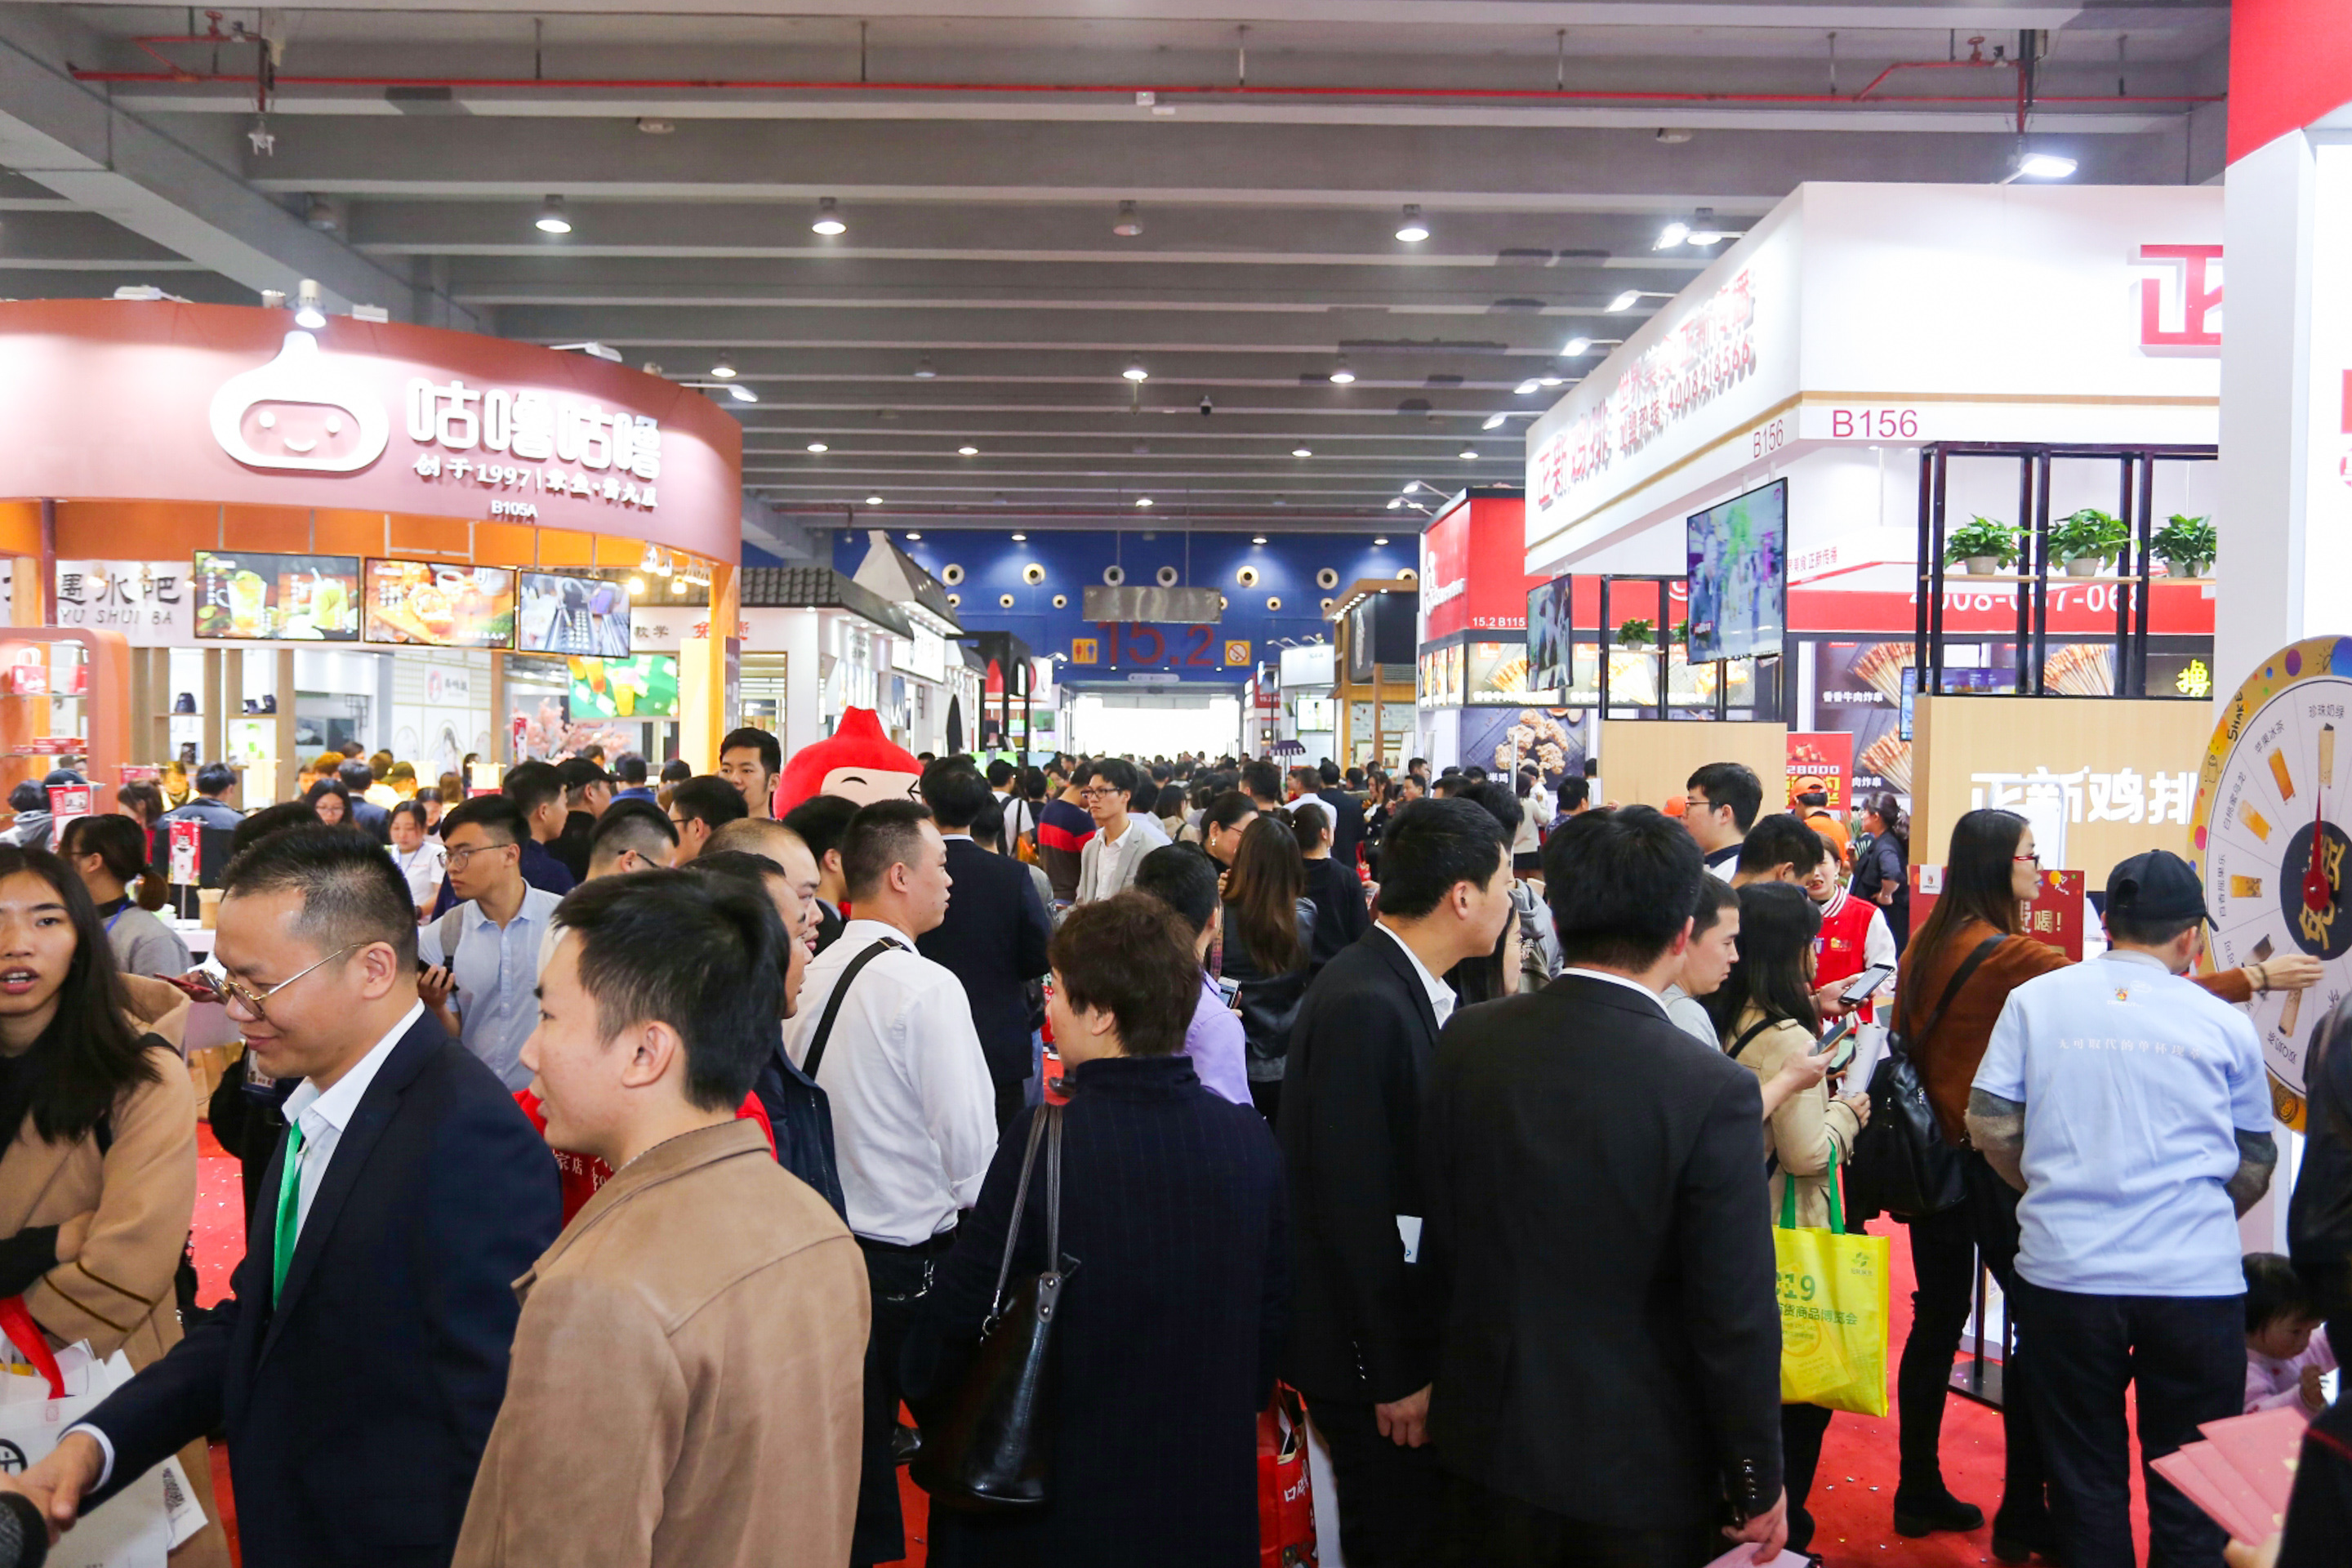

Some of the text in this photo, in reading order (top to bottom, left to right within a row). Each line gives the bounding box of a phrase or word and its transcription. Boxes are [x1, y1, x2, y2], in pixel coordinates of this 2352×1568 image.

[406, 376, 662, 480] 咕噜咕噜
[1753, 419, 1784, 459] B156
[1833, 409, 1918, 439] B156
[491, 500, 538, 518] B105A
[60, 608, 173, 626] YU SHUI BA
[1097, 621, 1215, 666] 15.2
[2226, 692, 2243, 742] SHAKE
[1970, 765, 2199, 825] 正新鸡排
[552, 1148, 582, 1175] 家店
